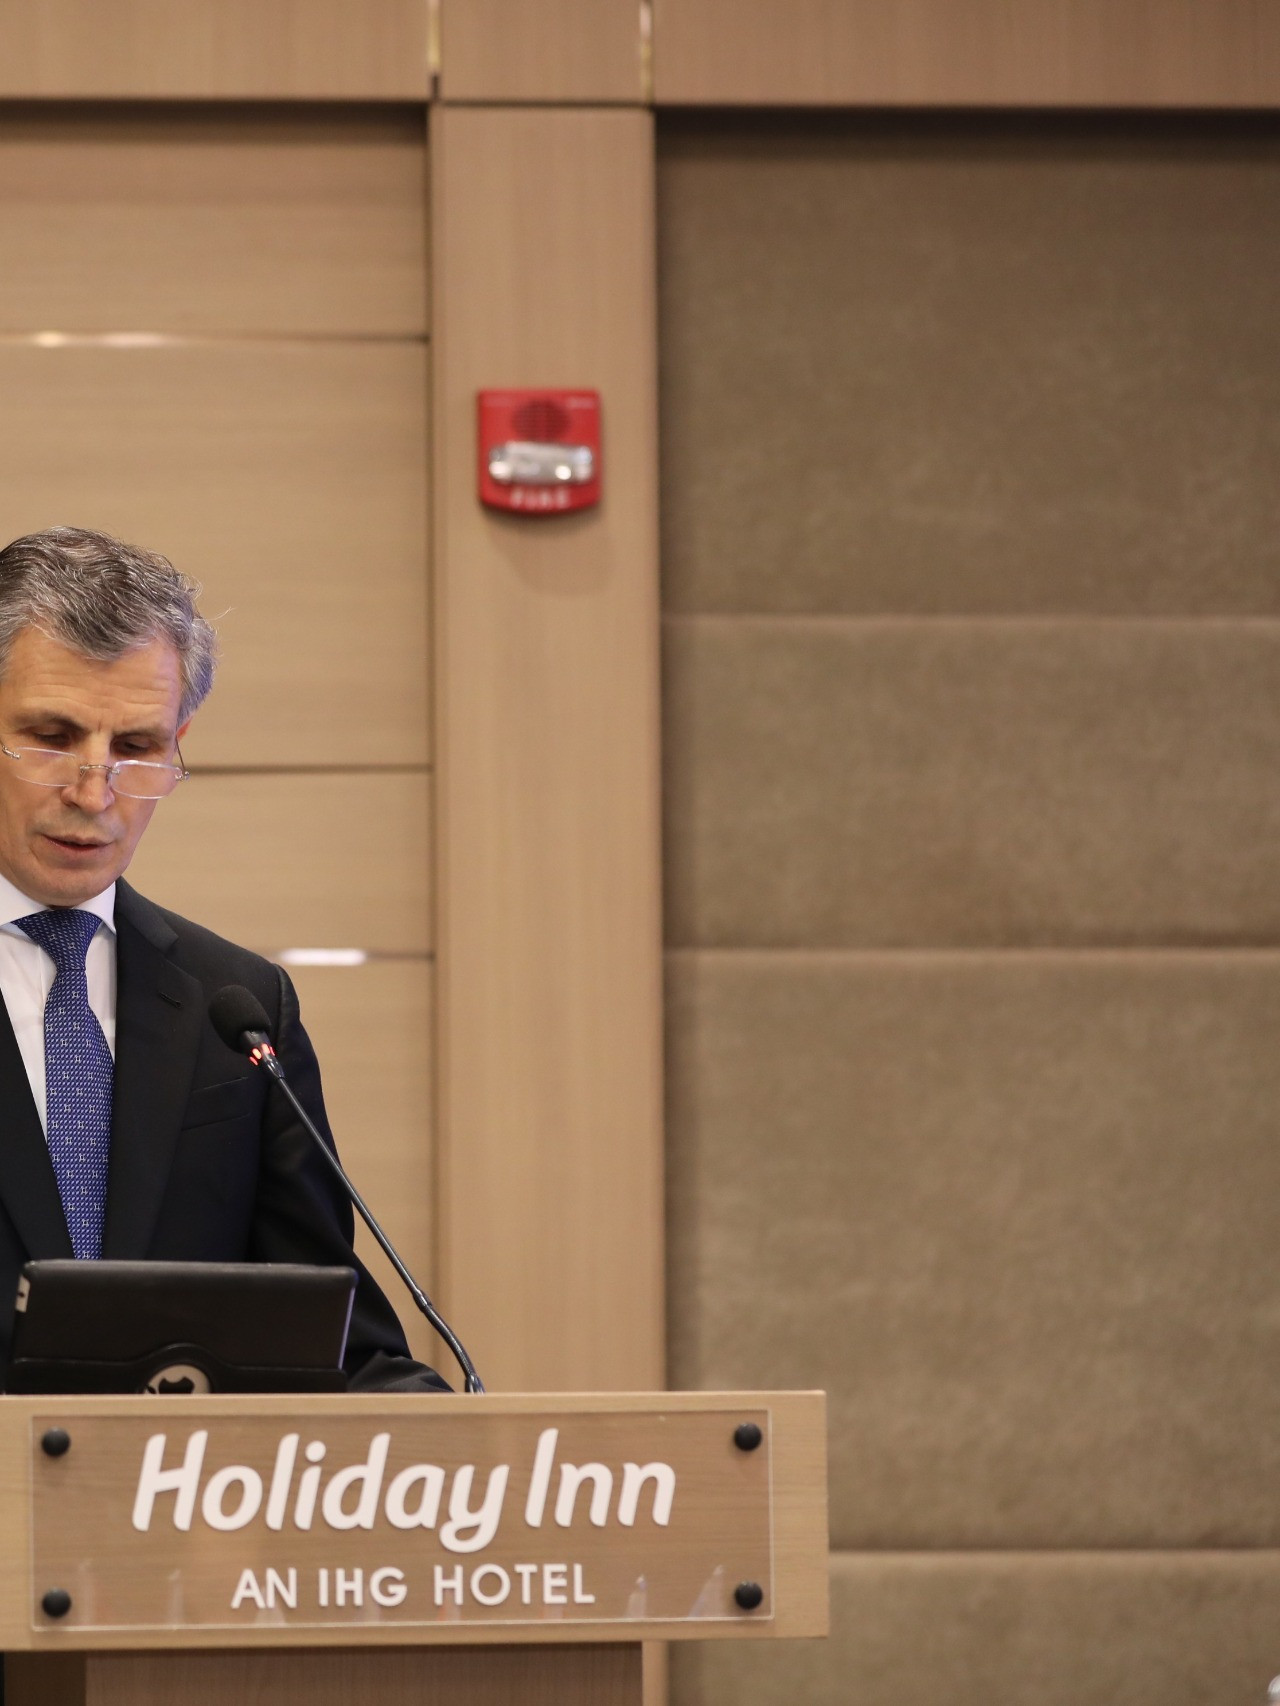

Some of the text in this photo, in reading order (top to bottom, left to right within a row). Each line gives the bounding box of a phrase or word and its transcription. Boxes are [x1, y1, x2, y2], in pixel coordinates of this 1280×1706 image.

[511, 487, 571, 510] FIRE
[132, 1428, 677, 1553] Holiday Inn
[231, 1563, 595, 1609] AN IHG HOTEL
